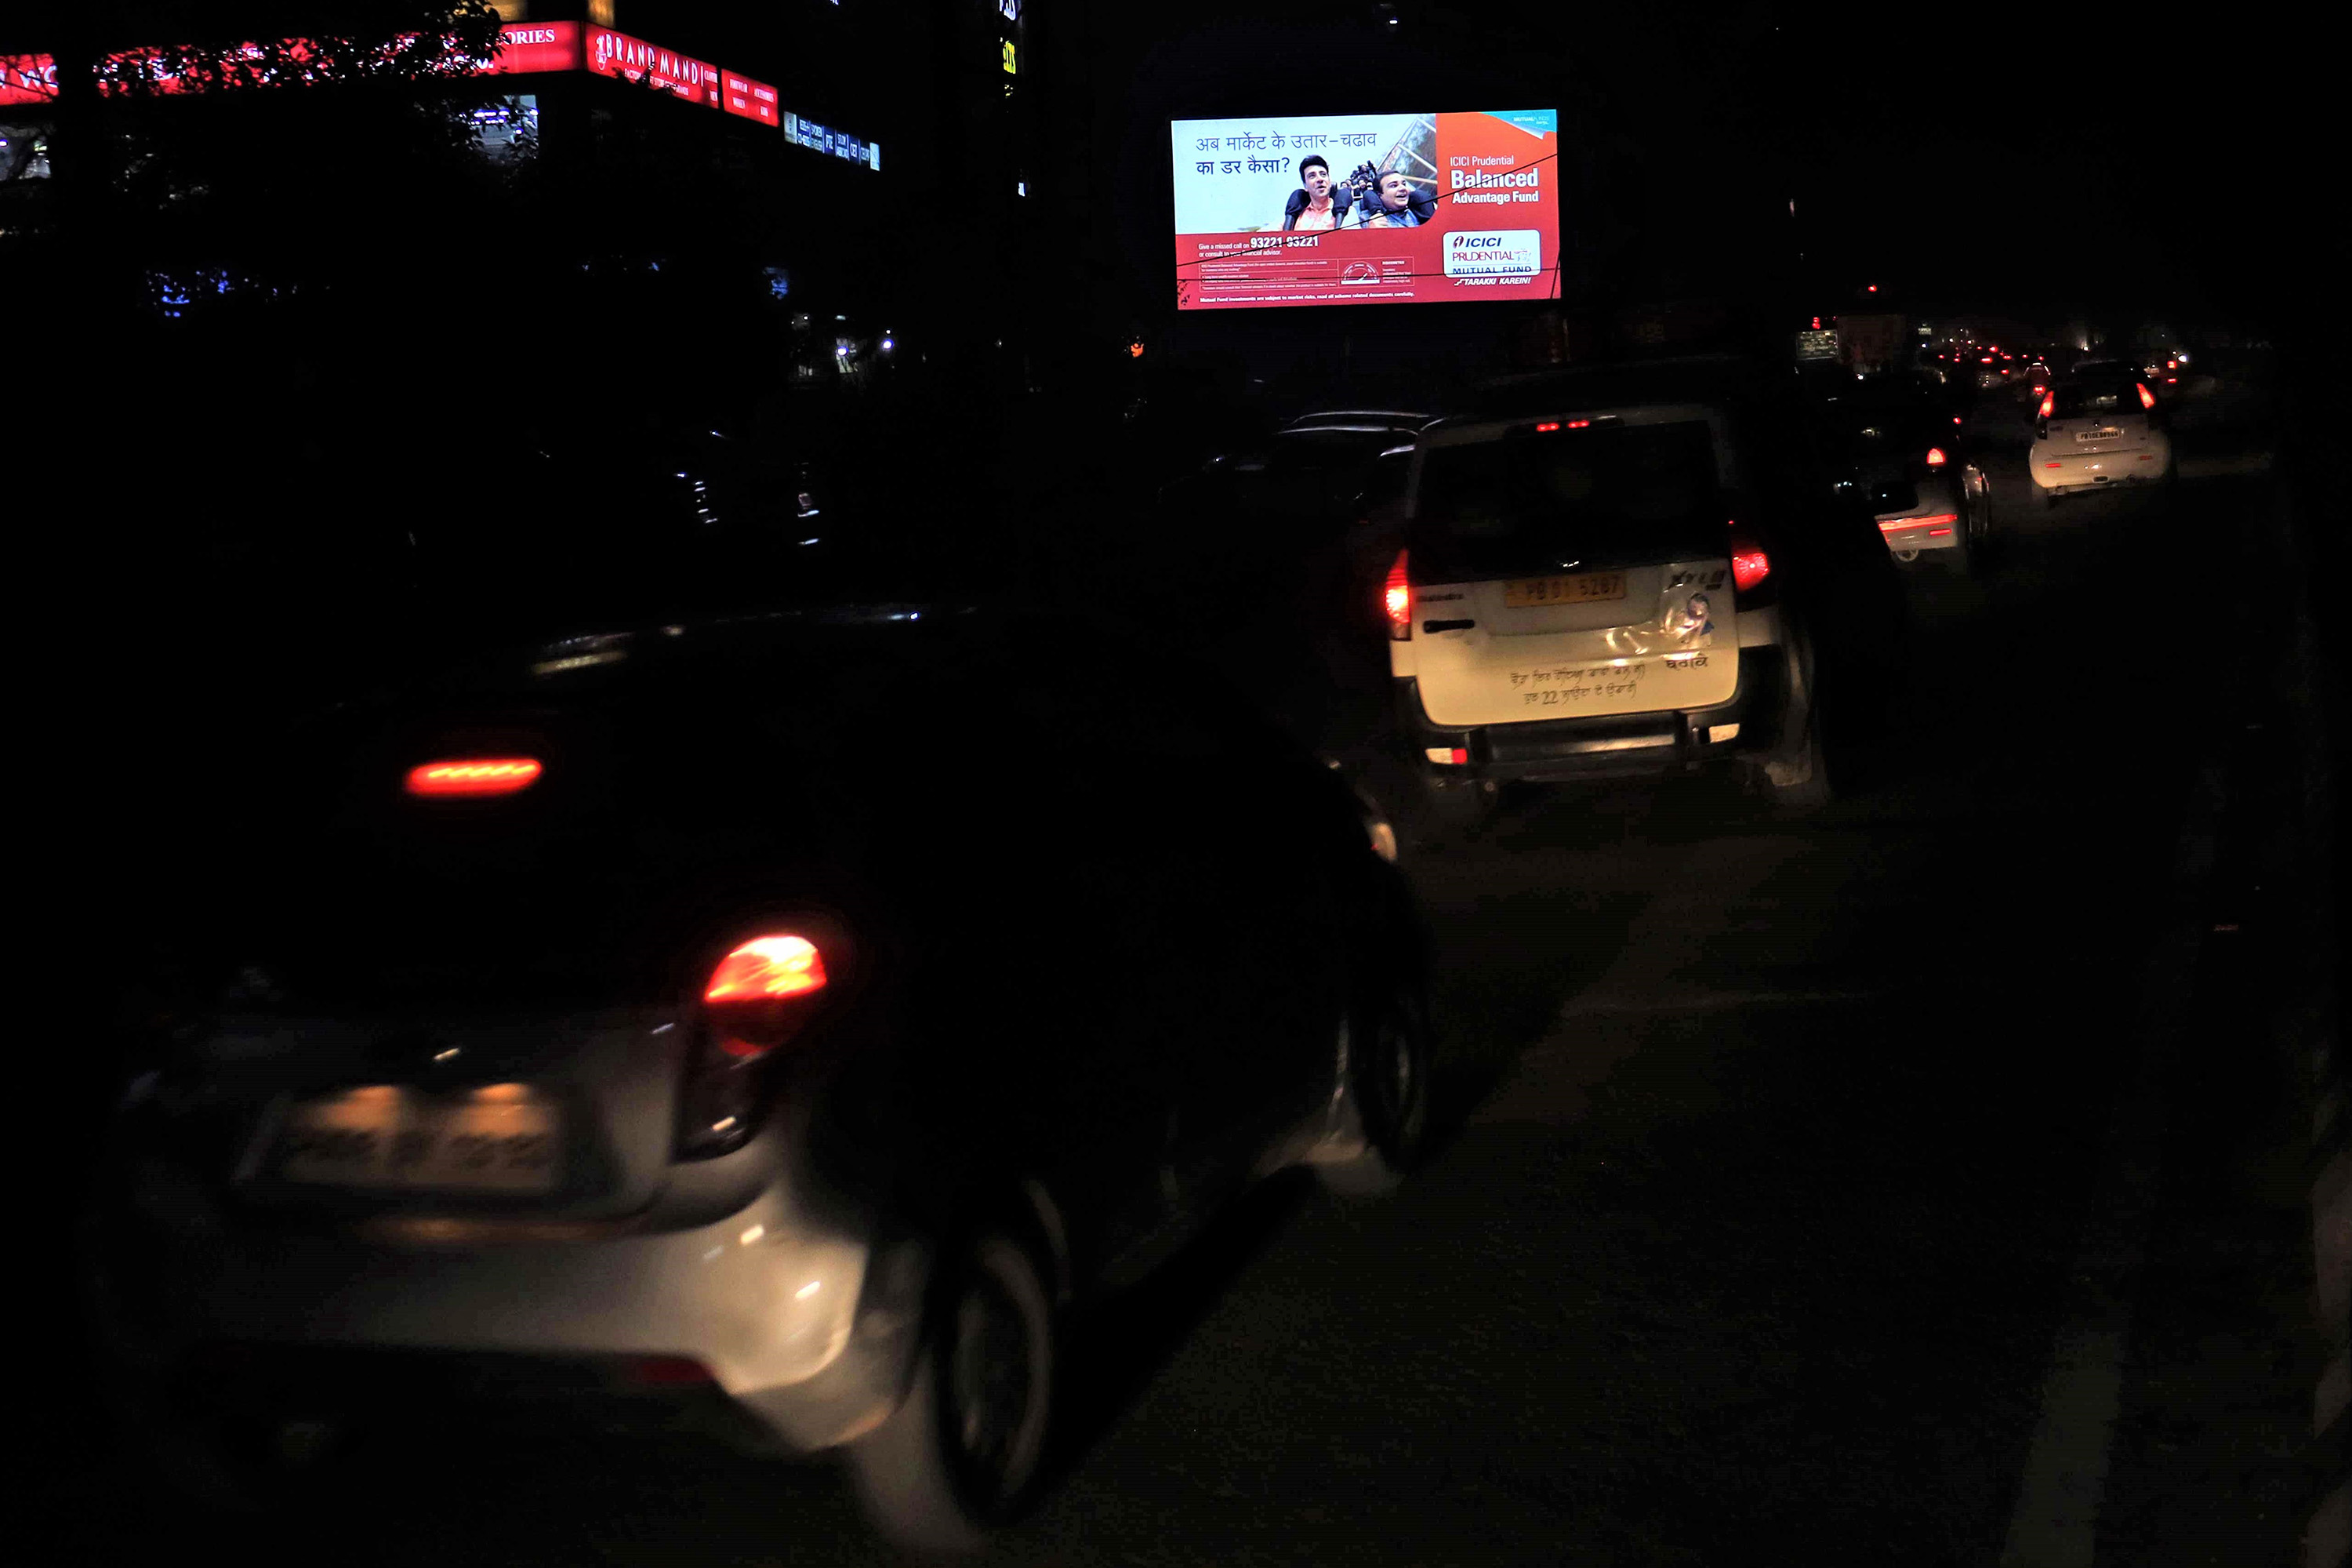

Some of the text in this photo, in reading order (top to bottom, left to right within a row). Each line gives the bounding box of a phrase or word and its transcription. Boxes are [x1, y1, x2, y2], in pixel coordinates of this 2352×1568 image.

[505, 29, 555, 45] ORIES
[606, 33, 705, 87] BRAND MANDI
[1196, 137, 1220, 151] अब
[1226, 132, 1266, 151] मार्केट
[1271, 130, 1286, 150] के
[1196, 154, 1290, 175] का डर कैसा?
[1450, 155, 1514, 166] ICICI Prudential
[1451, 168, 1539, 189] Balanced
[1452, 191, 1539, 205] Advantage Fund
[1465, 238, 1502, 248] ICICI
[1452, 251, 1514, 262] PRUDENTIAL
[1465, 278, 1497, 286] TARAKKI
